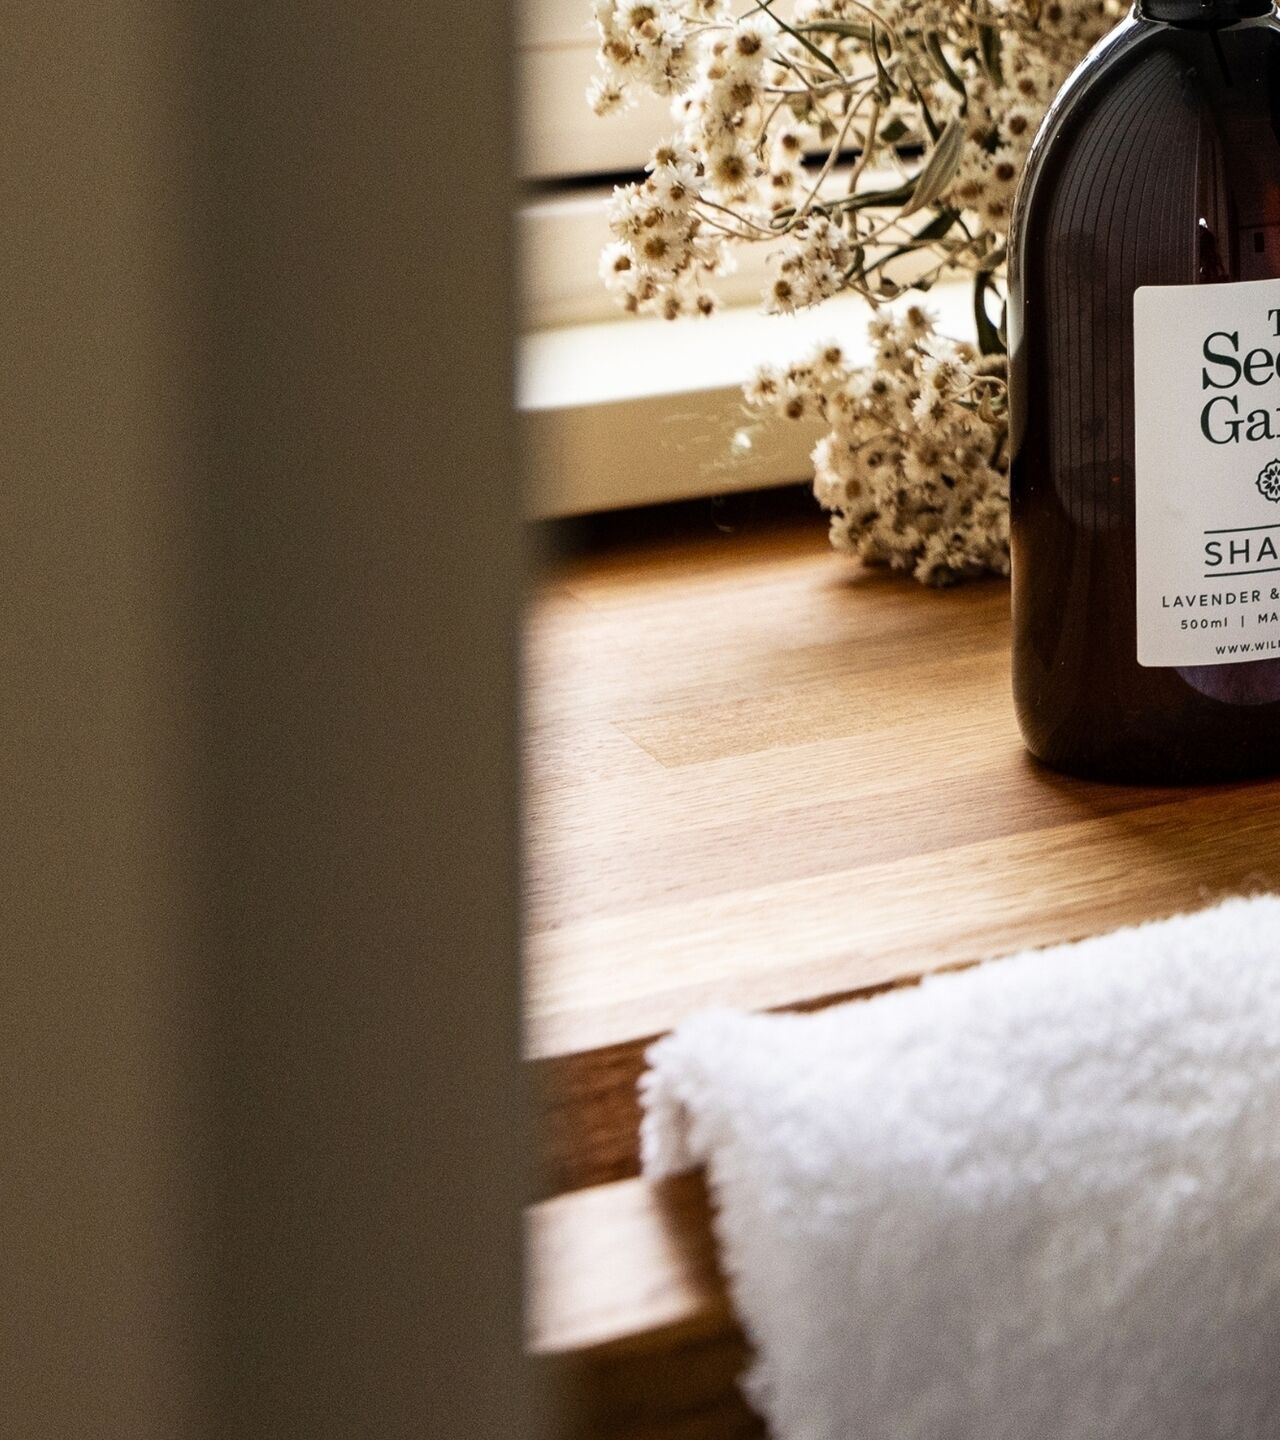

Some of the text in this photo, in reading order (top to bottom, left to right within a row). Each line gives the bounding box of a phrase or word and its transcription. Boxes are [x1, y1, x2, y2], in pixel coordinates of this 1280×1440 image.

[1162, 589, 1261, 608] LAVENDER
[1270, 588, 1280, 600] &
[1180, 617, 1229, 630] 500ml
